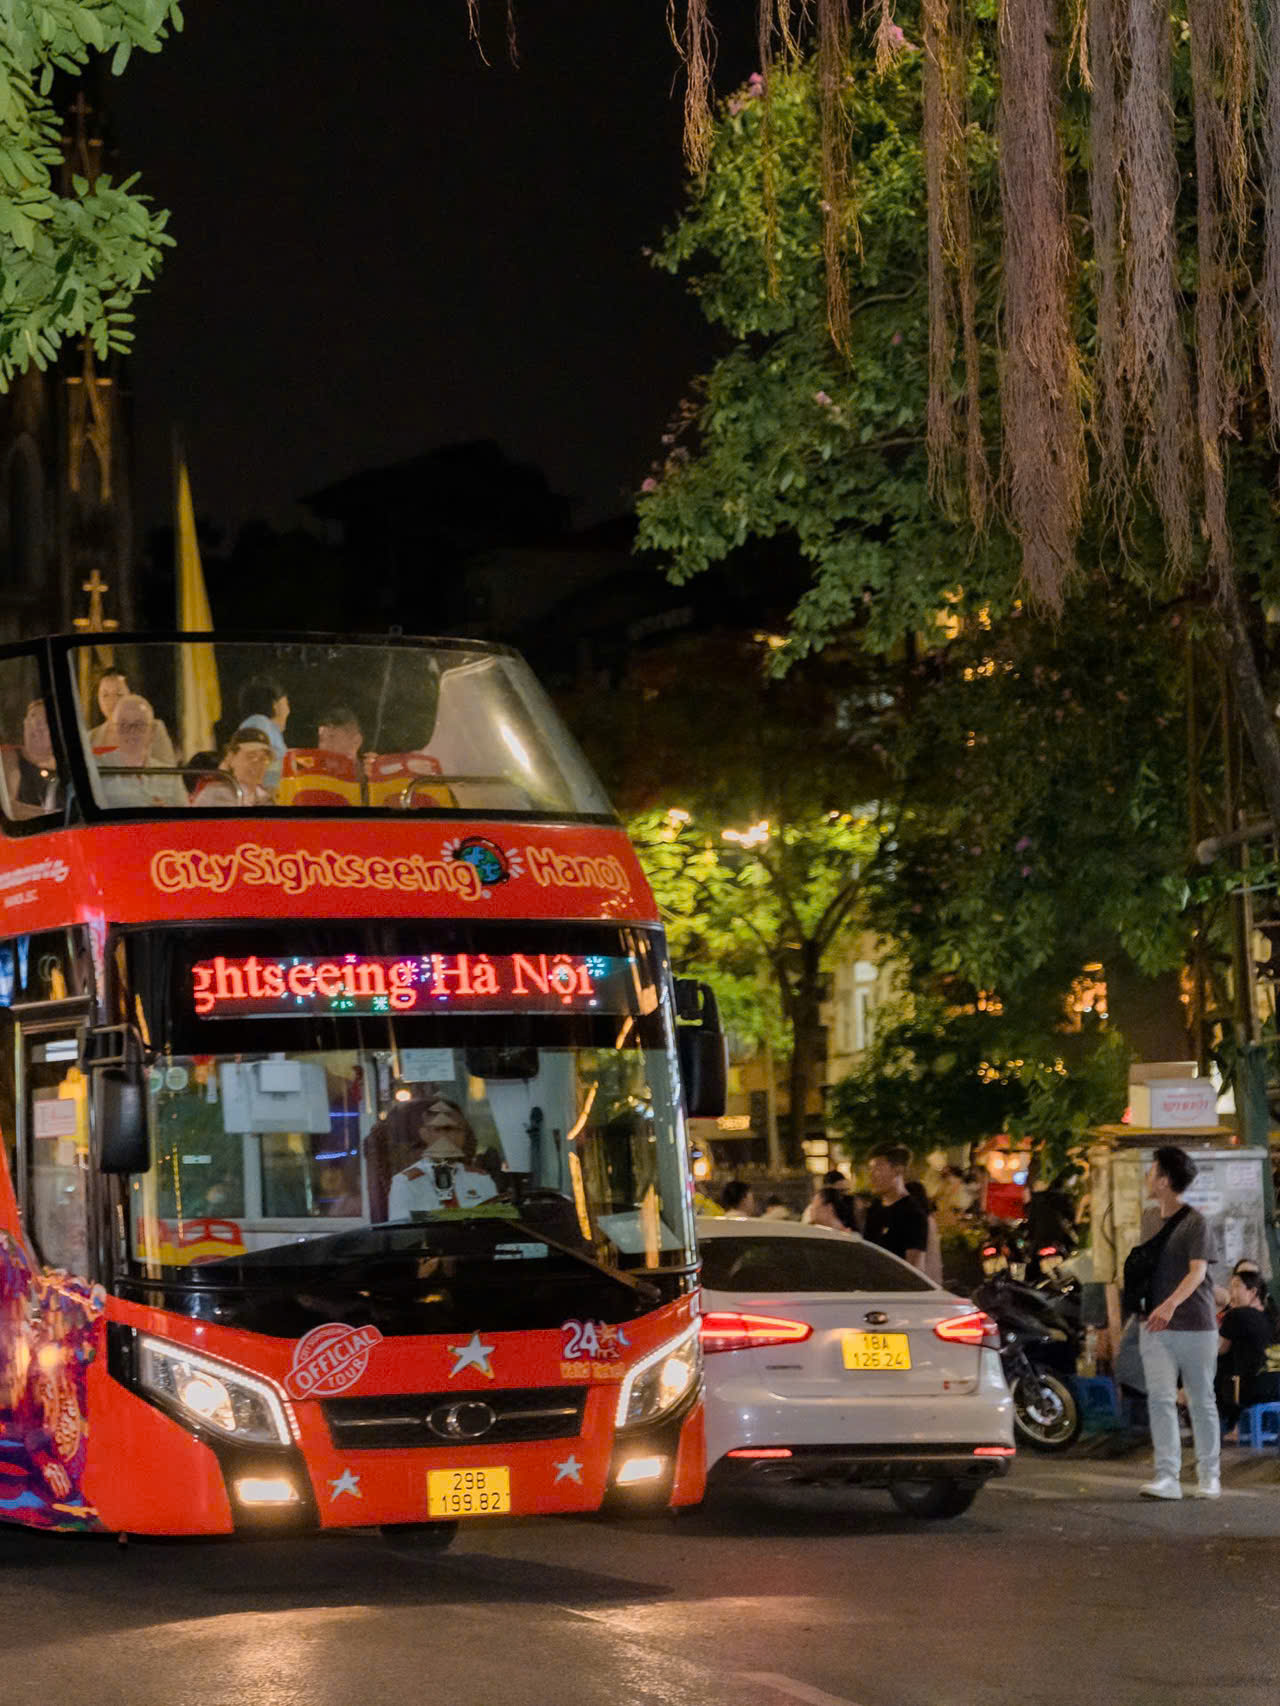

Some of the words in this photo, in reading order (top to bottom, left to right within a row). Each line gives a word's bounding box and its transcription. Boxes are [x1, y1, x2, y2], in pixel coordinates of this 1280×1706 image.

[525, 845, 631, 892] Hanoi
[429, 953, 500, 996] Hà
[512, 953, 595, 1005] Nội
[561, 1321, 600, 1359] 24
[295, 1330, 378, 1390] OFFICIAL
[327, 1358, 366, 1388] TOUR
[453, 1471, 486, 1490] 29B
[441, 1491, 501, 1513] 199.82
